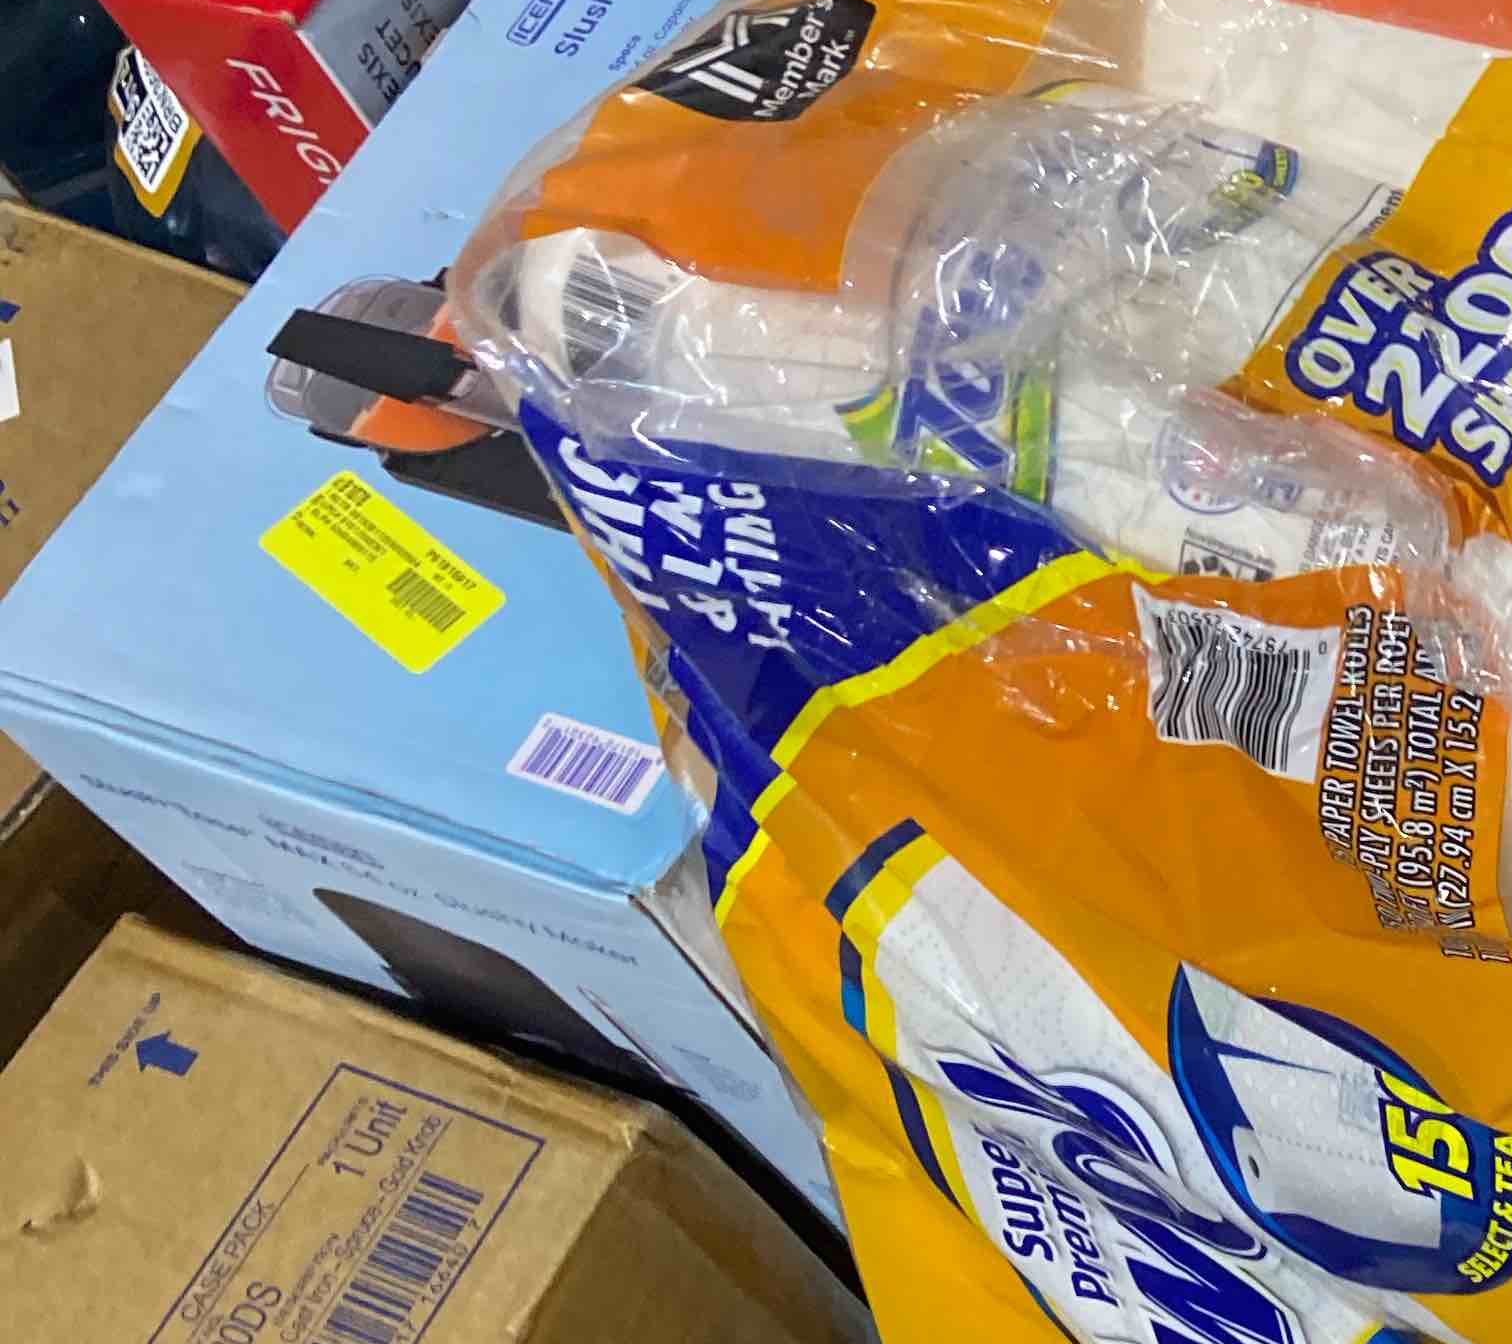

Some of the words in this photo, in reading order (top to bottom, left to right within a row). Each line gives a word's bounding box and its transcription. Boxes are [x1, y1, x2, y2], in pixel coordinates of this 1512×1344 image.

[227, 57, 343, 186] FRIG
[1297, 256, 1435, 391] OVER
[1340, 604, 1372, 688] ROLLS
[1327, 696, 1365, 772] TOWEL
[1374, 682, 1404, 731] PER
[1407, 689, 1444, 762] TOTAL
[1360, 734, 1399, 825] SHEETS
[1444, 759, 1475, 782] X
[1450, 785, 1477, 820] cm
[1320, 775, 1355, 849] PAPER
[1398, 818, 1435, 891] (95.8
[346, 1098, 408, 1159] Unit
[332, 1157, 367, 1179] 1
[982, 1128, 1057, 1265] Supe
[181, 1266, 225, 1325] CASE
[223, 1197, 277, 1265] PACK
